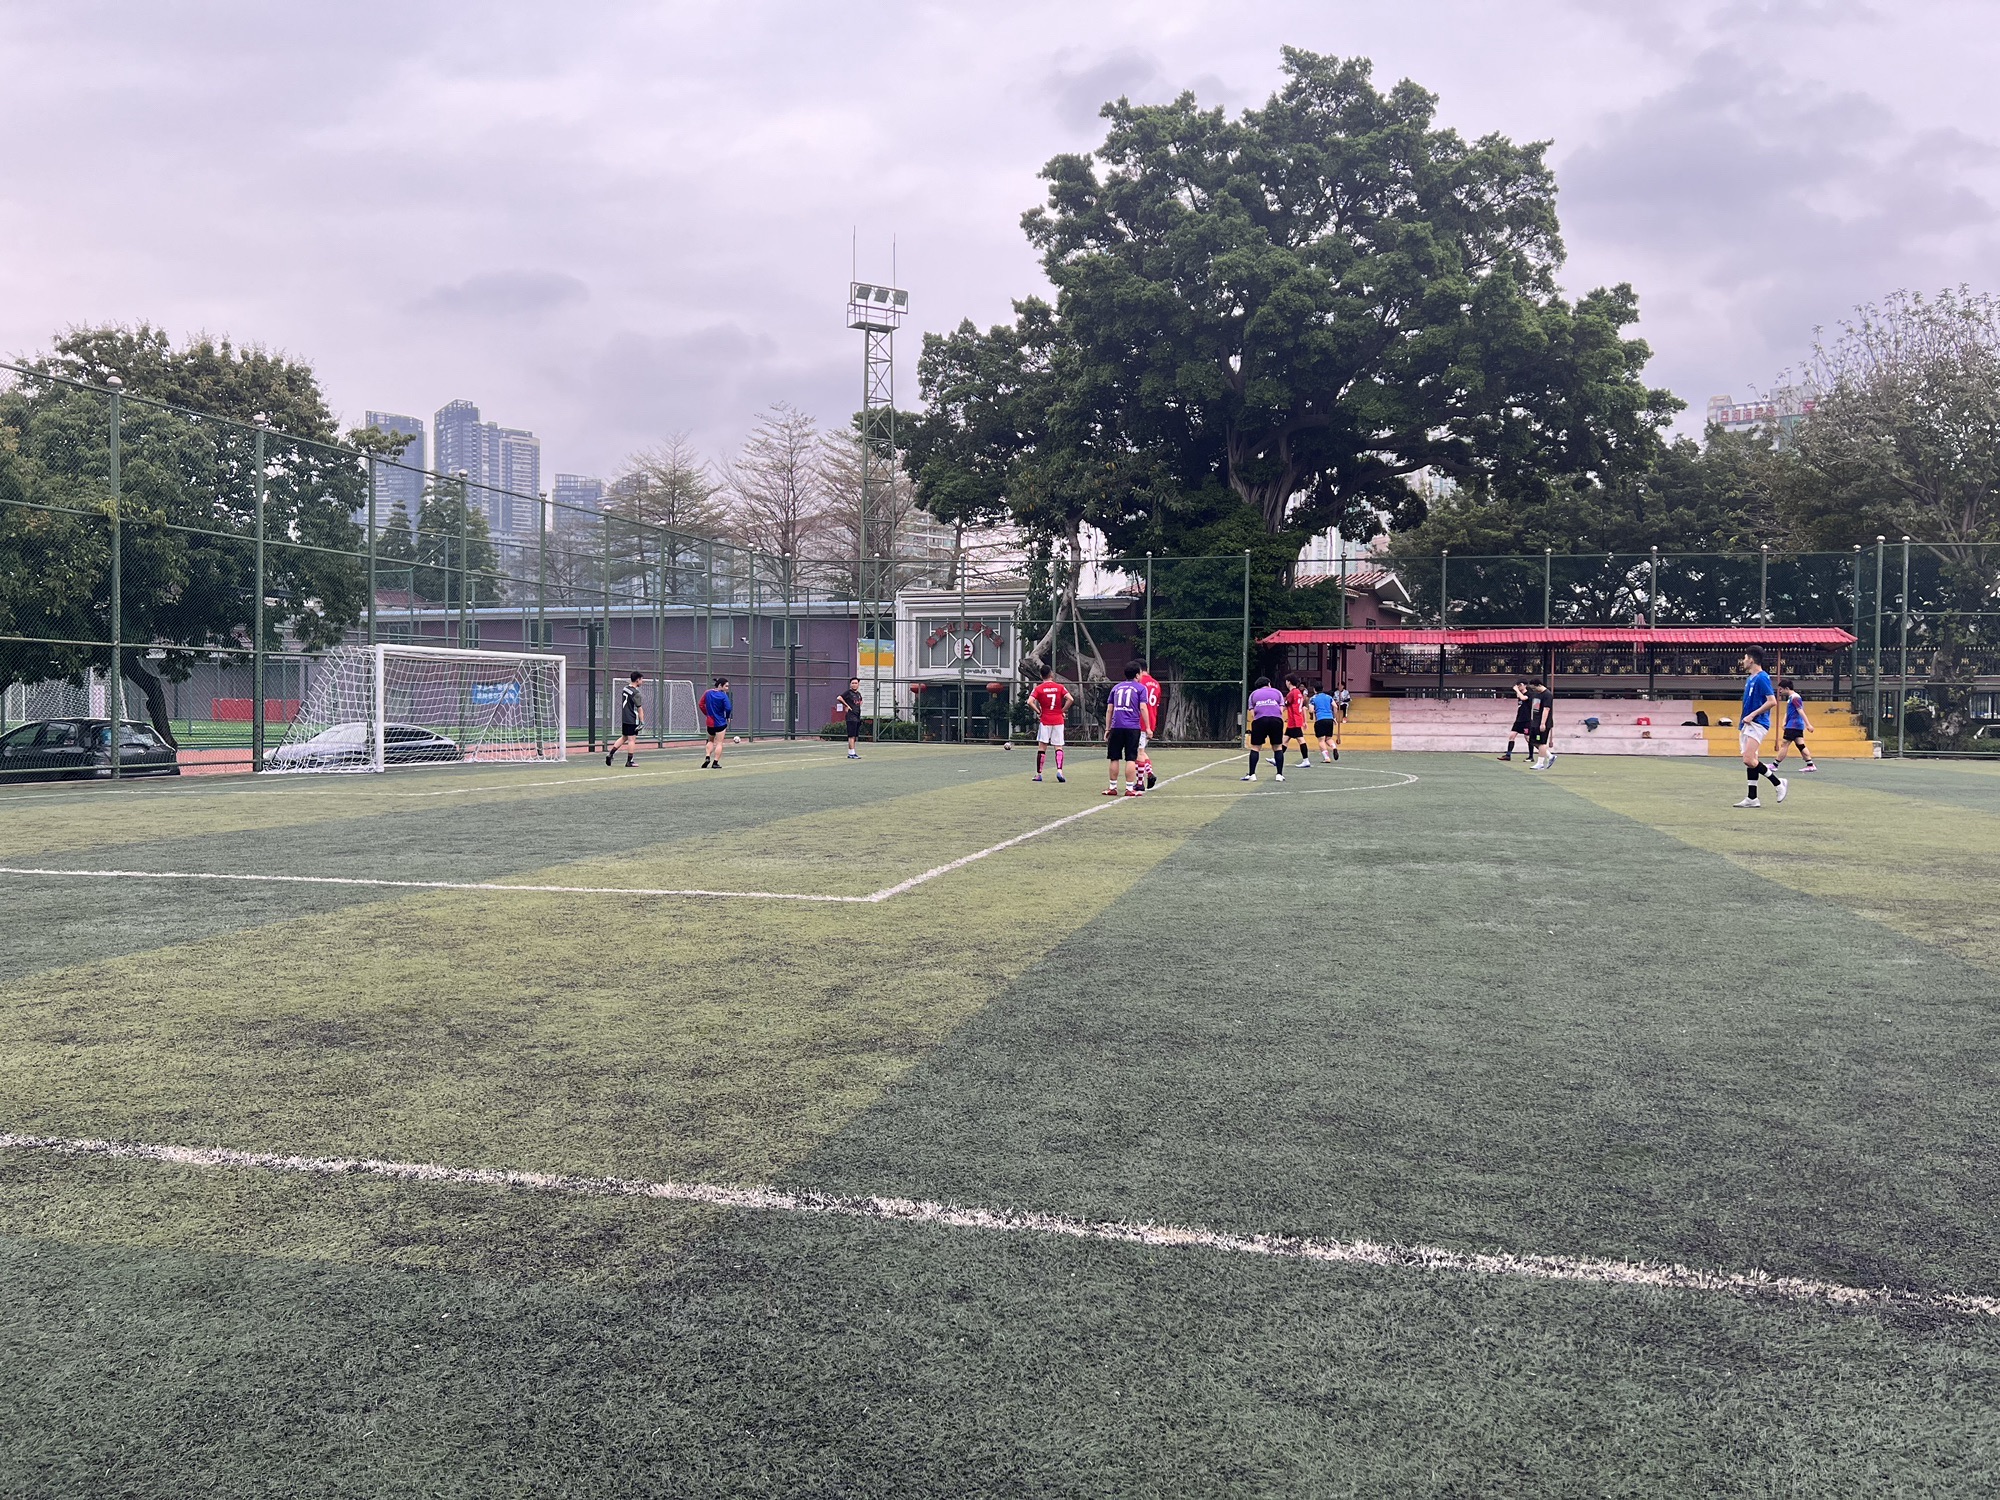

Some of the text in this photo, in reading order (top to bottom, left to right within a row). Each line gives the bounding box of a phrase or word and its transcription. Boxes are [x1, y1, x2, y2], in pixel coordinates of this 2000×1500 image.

[622, 692, 628, 709] 7
[1046, 693, 1056, 710] 7
[1117, 688, 1132, 706] 11
[1149, 688, 1157, 706] 6
